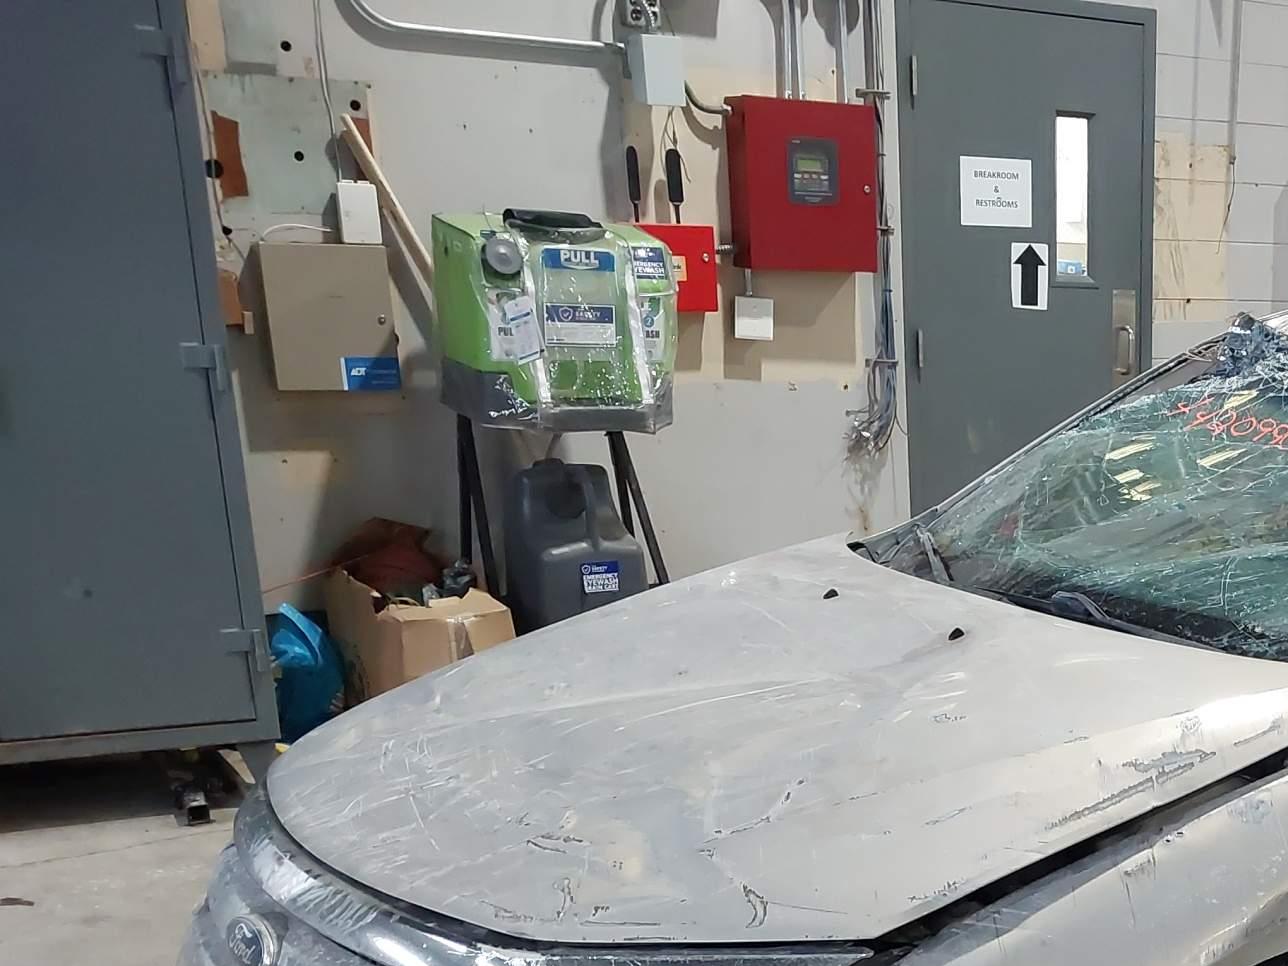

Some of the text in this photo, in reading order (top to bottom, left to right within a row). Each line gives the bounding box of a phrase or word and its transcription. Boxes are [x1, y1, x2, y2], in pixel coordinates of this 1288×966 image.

[973, 170, 1019, 180] BREAKROOM
[993, 185, 999, 193] &
[975, 198, 1018, 209] RESTROOMS
[560, 249, 599, 264] PULL
[229, 923, 256, 964] Ford
